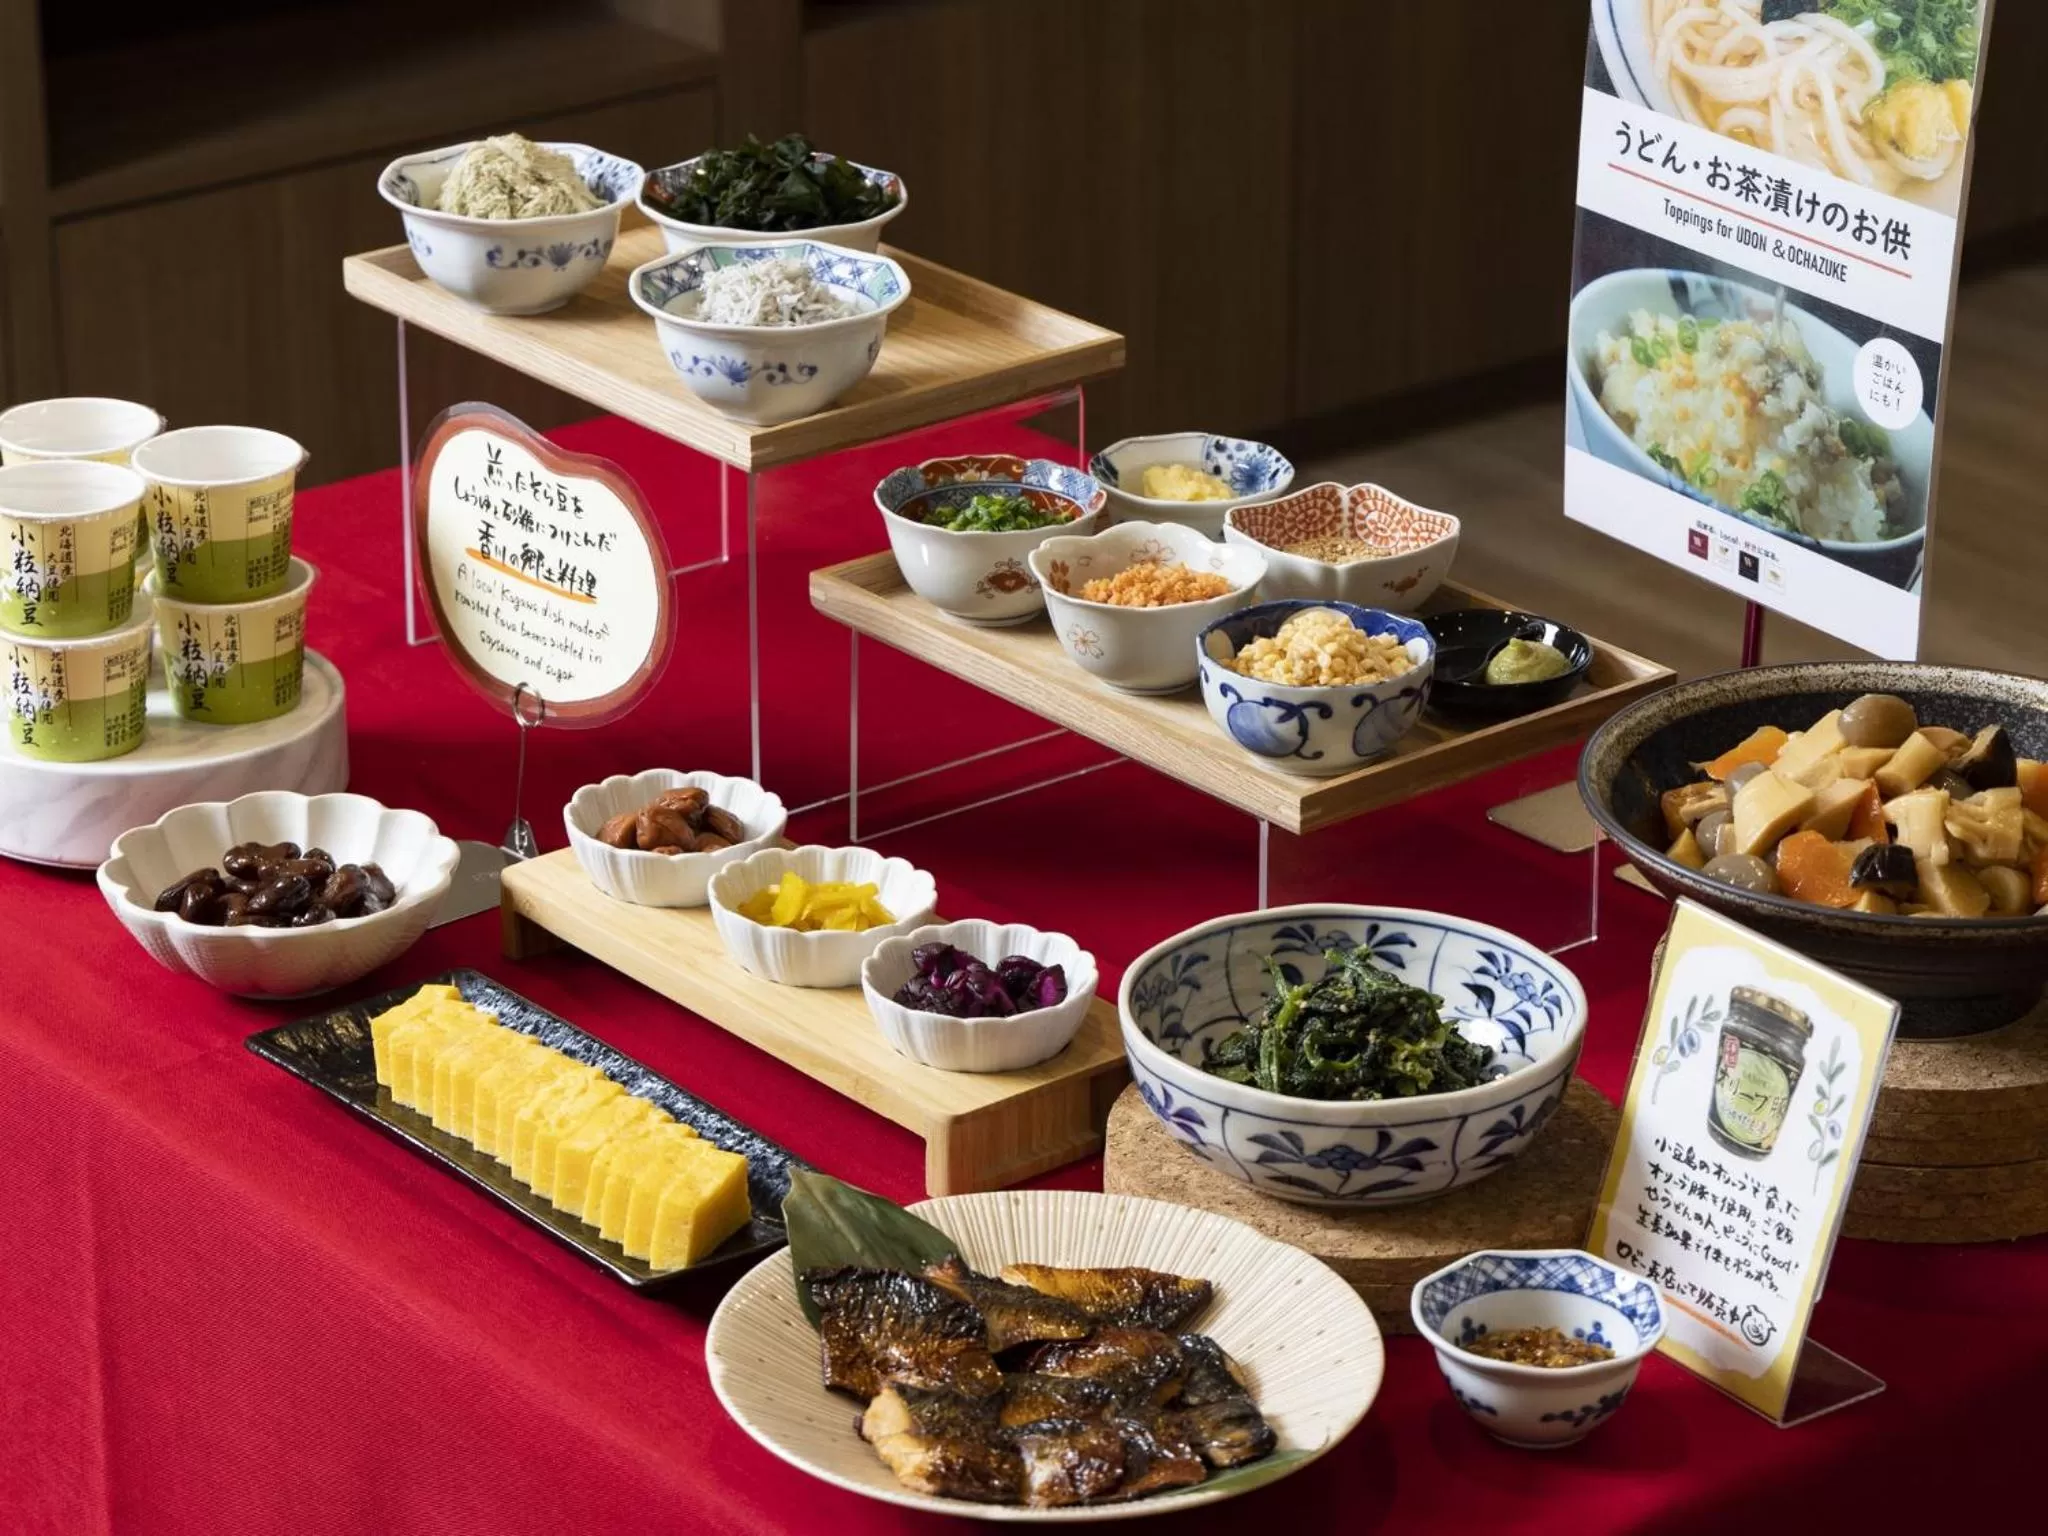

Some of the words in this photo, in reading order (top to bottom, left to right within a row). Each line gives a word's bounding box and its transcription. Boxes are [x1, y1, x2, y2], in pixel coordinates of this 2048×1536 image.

[1616, 121, 1911, 260] うどん・お茶漬けのお供
[1664, 198, 1713, 233] Toppings
[1717, 219, 1733, 239] for
[1736, 226, 1767, 252] UDON
[1773, 239, 1786, 257] &
[1788, 245, 1848, 283] OCHAZUKE
[1872, 372, 1904, 394] ごはん
[153, 486, 183, 587] 小粒納豆
[181, 515, 198, 565] 大豆使用
[194, 491, 207, 543] 北海道産
[11, 524, 43, 626] 小粒納豆
[60, 525, 74, 576] 北海道産
[478, 520, 597, 599] 香川の郷土料理
[45, 552, 62, 602] 大豆使用
[457, 562, 467, 580] A
[472, 570, 496, 598] local
[501, 583, 538, 612] Kagawa
[542, 602, 565, 626] dish
[569, 619, 596, 637] made
[224, 614, 240, 665] 北海道産
[455, 589, 490, 618] roasted
[494, 612, 517, 632] fava
[521, 621, 547, 646] beans
[589, 649, 603, 664] in
[51, 651, 65, 702] 北海道産
[178, 613, 212, 712] 小粒納豆
[213, 641, 226, 688] 大豆使用
[524, 655, 543, 669] and
[546, 663, 575, 683] sugar
[9, 646, 40, 748] 小粒納豆
[40, 676, 54, 725] 大豆使用
